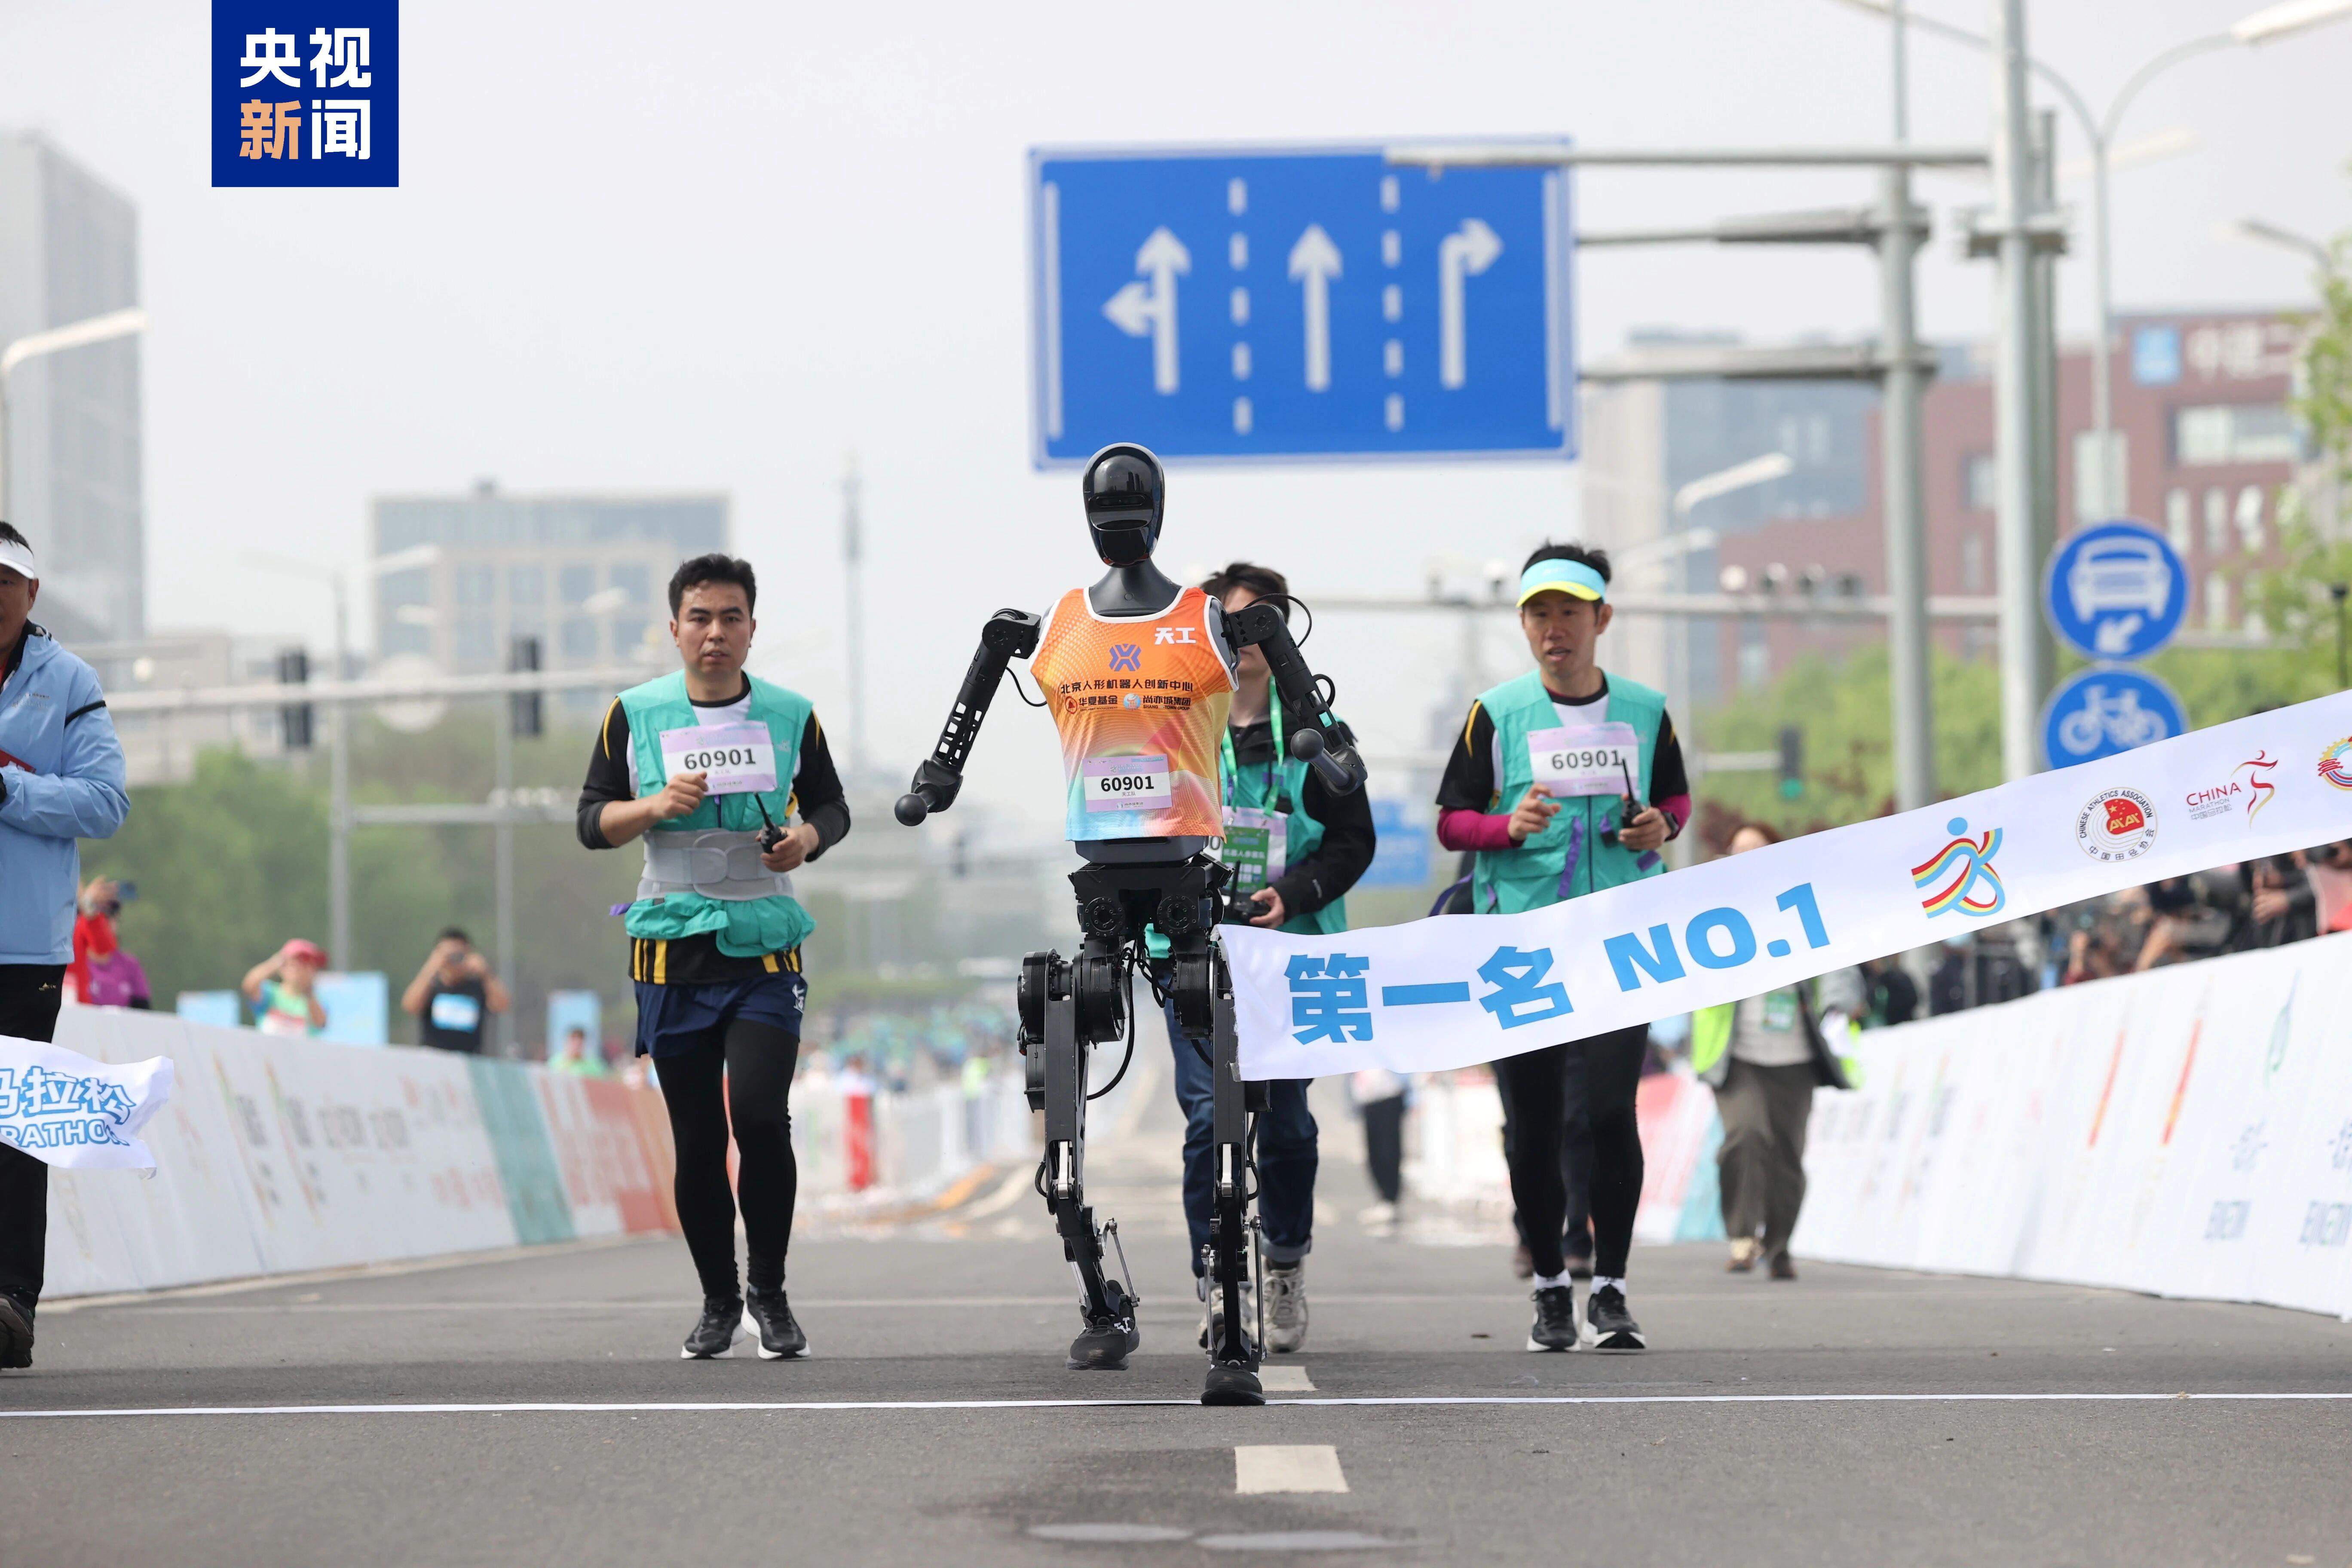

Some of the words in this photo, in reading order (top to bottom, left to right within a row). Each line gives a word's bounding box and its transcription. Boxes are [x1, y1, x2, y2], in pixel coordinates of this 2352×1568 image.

[1155, 627, 1196, 645] 天工
[1061, 679, 1193, 694] 北京人形机器人创新中心
[1079, 695, 1118, 706] 华夏基金
[1143, 695, 1191, 706] 尚亦城集团
[684, 747, 756, 770] 60901
[1552, 749, 1622, 769] 60901
[1101, 775, 1155, 792] 60901
[2186, 782, 2242, 806] CHINA
[2189, 797, 2230, 813] MARATHON
[2190, 803, 2233, 820] 中国马拉松
[2079, 812, 2090, 839] CHINESE
[2087, 790, 2119, 812] ATHLETICS
[2121, 790, 2153, 818] ASSOCIATION
[2089, 828, 2155, 861] 中国田径协会
[1284, 946, 1574, 1045] 第一名
[1603, 882, 1831, 992] NO.1
